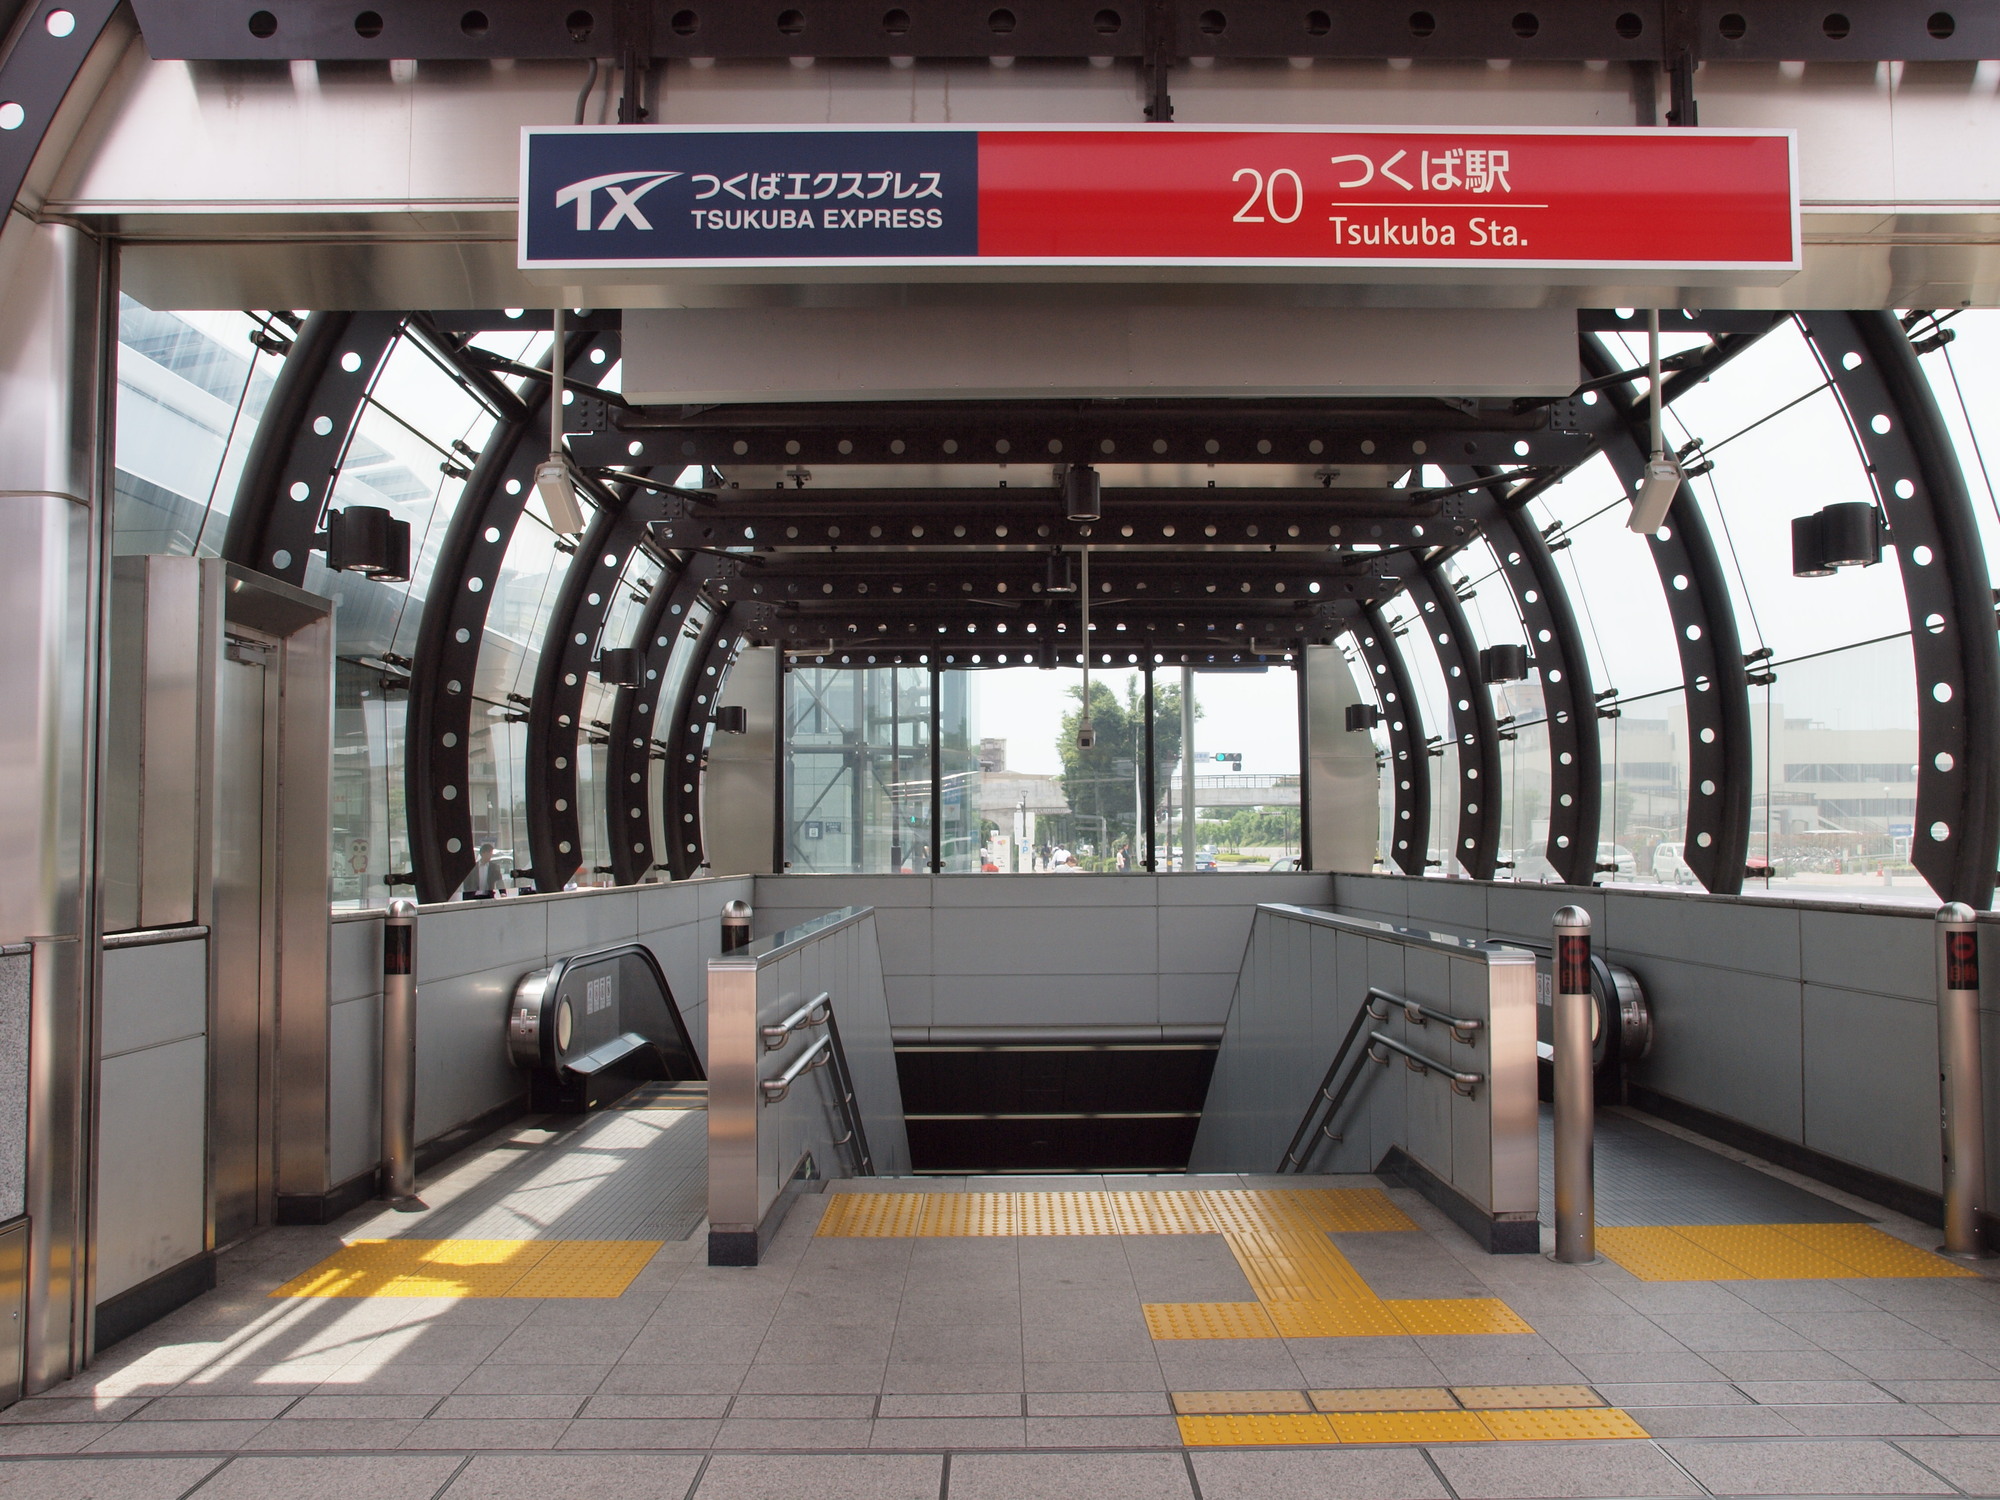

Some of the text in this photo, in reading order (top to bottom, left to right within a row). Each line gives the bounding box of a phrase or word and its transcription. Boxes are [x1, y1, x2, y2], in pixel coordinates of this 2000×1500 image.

[691, 170, 943, 201] つくばエクスプレス
[1331, 147, 1512, 194] つくば駅
[556, 171, 683, 231] TX
[1232, 167, 1303, 224] 20
[691, 208, 943, 230] TSUKUBA EXPRESS
[1328, 216, 1529, 247] Tsukuba Sta.
